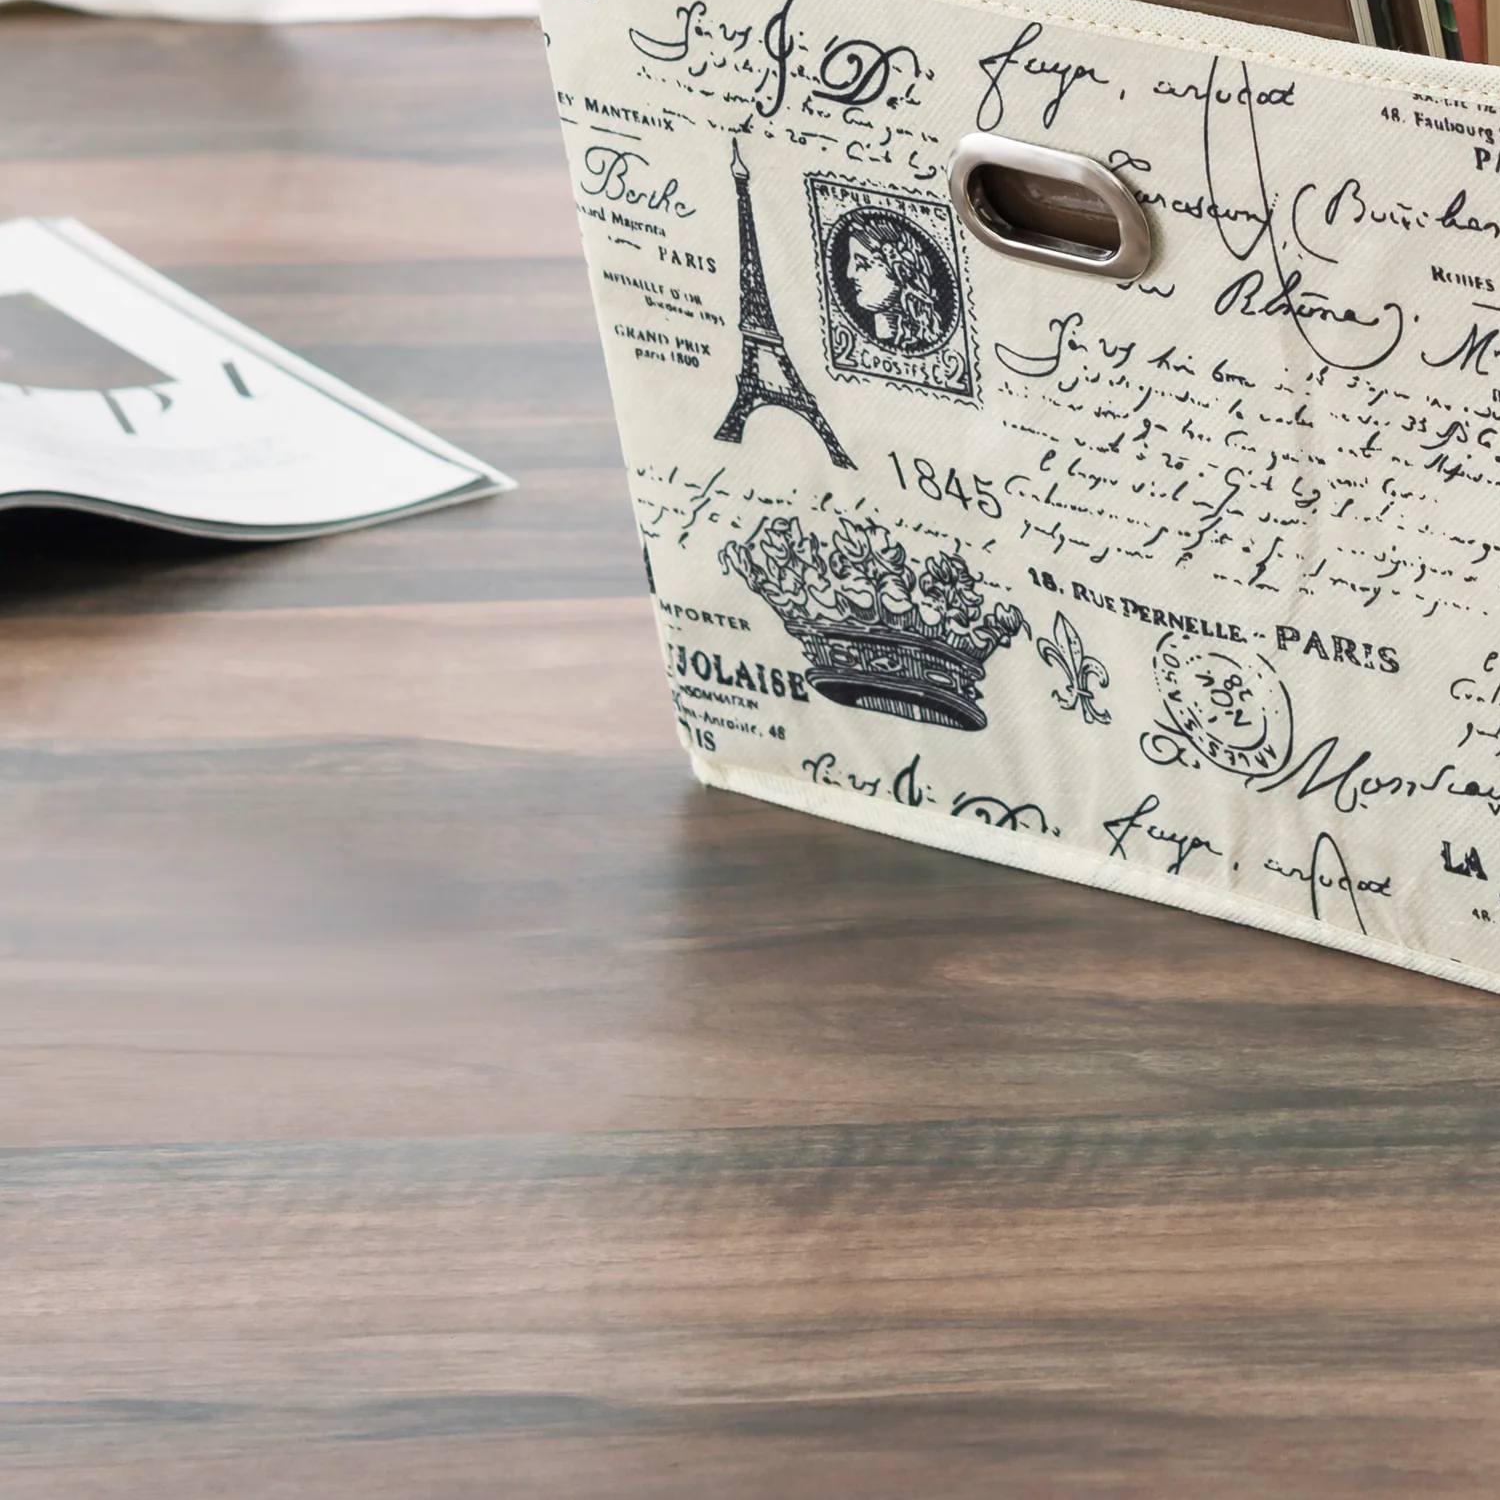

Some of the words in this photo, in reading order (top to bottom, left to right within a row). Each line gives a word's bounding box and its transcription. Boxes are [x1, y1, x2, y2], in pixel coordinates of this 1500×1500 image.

[585, 97, 675, 132] MANTEAUX
[1414, 112, 1495, 145] Faubourg
[658, 245, 717, 274] PARIS
[614, 324, 669, 347] GRAND
[887, 450, 1002, 519] 1845
[1071, 581, 1117, 612] RUE
[1276, 624, 1401, 674] PARIS
[1441, 840, 1488, 881] LA
